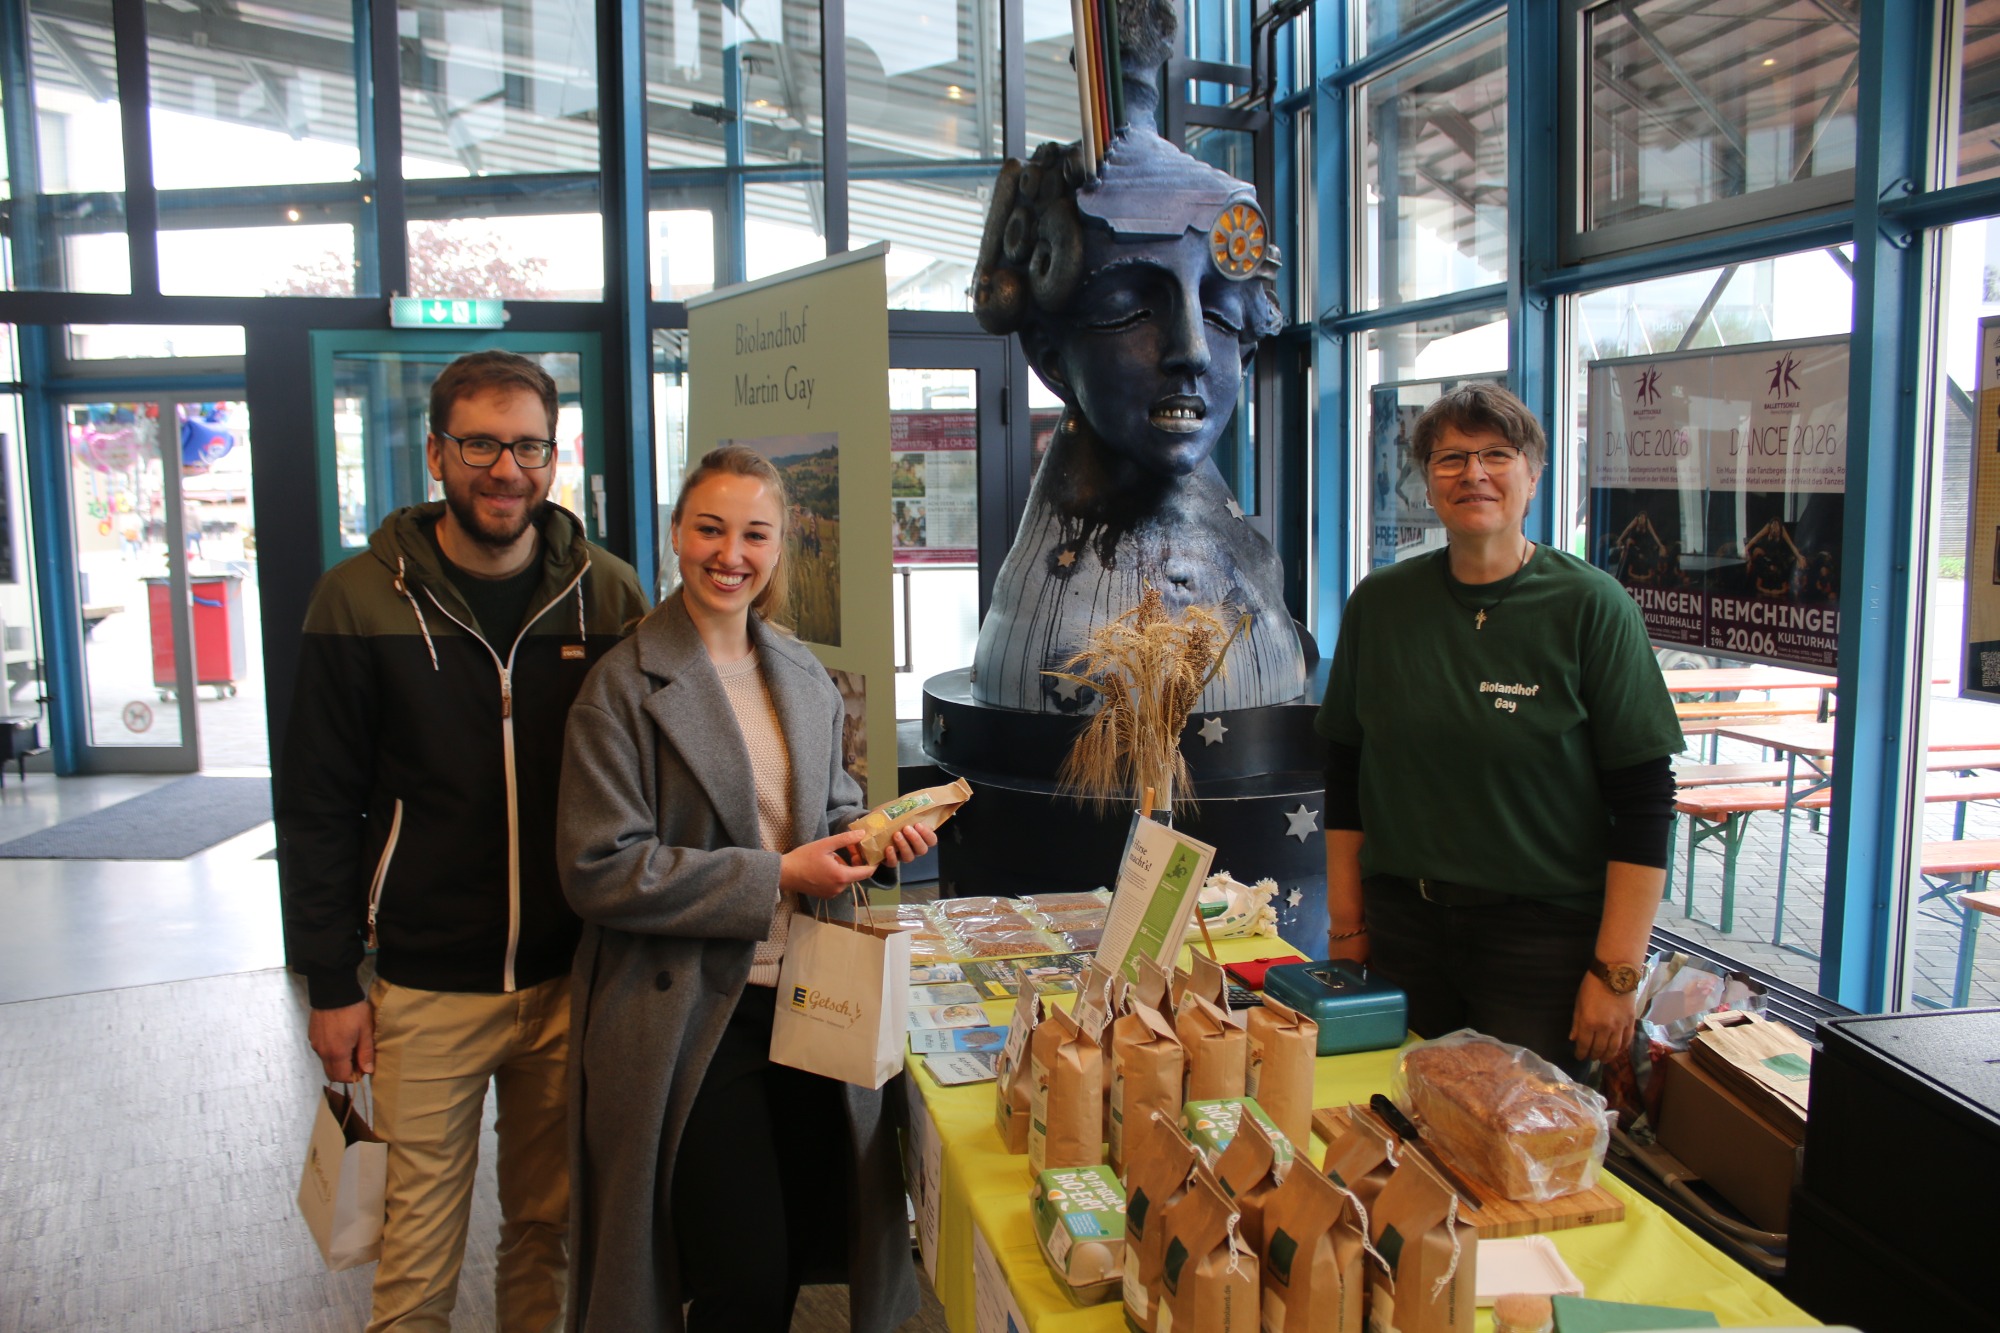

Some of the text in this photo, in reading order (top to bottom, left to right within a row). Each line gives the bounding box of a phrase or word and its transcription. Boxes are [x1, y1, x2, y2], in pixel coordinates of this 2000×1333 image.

[736, 304, 809, 355] Biolandhof
[735, 365, 815, 410] Martin Gay
[1764, 402, 1800, 410] BALLETTSCHULE
[1606, 429, 1689, 457] DANCE 2026
[1729, 423, 1837, 456] DANCE 2026
[1644, 612, 1701, 630] KULTURHALLE
[1710, 626, 1722, 636] Sa.
[1711, 637, 1724, 648] 19h
[1726, 627, 1778, 657] 20.06.
[1479, 681, 1539, 696] Biolandhof
[1494, 698, 1517, 713] Gay
